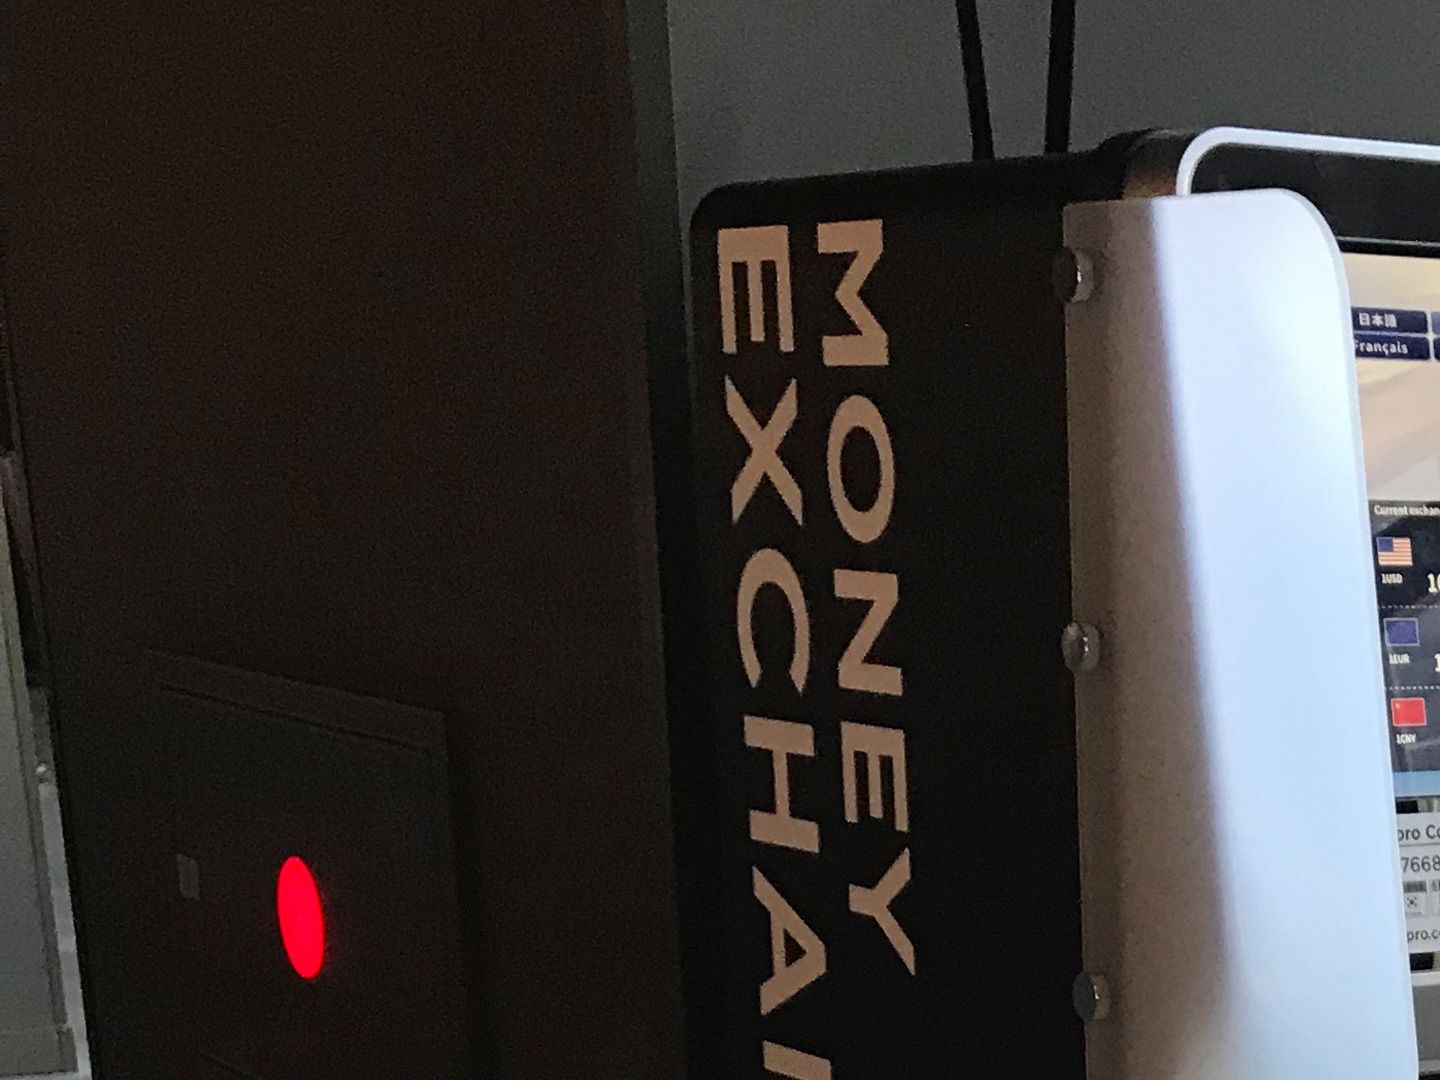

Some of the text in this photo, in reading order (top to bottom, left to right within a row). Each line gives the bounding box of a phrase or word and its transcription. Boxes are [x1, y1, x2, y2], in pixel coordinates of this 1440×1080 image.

[1358, 313, 1397, 328] 日本語
[1374, 505, 1408, 516] Current
[817, 219, 915, 976] MONEY
